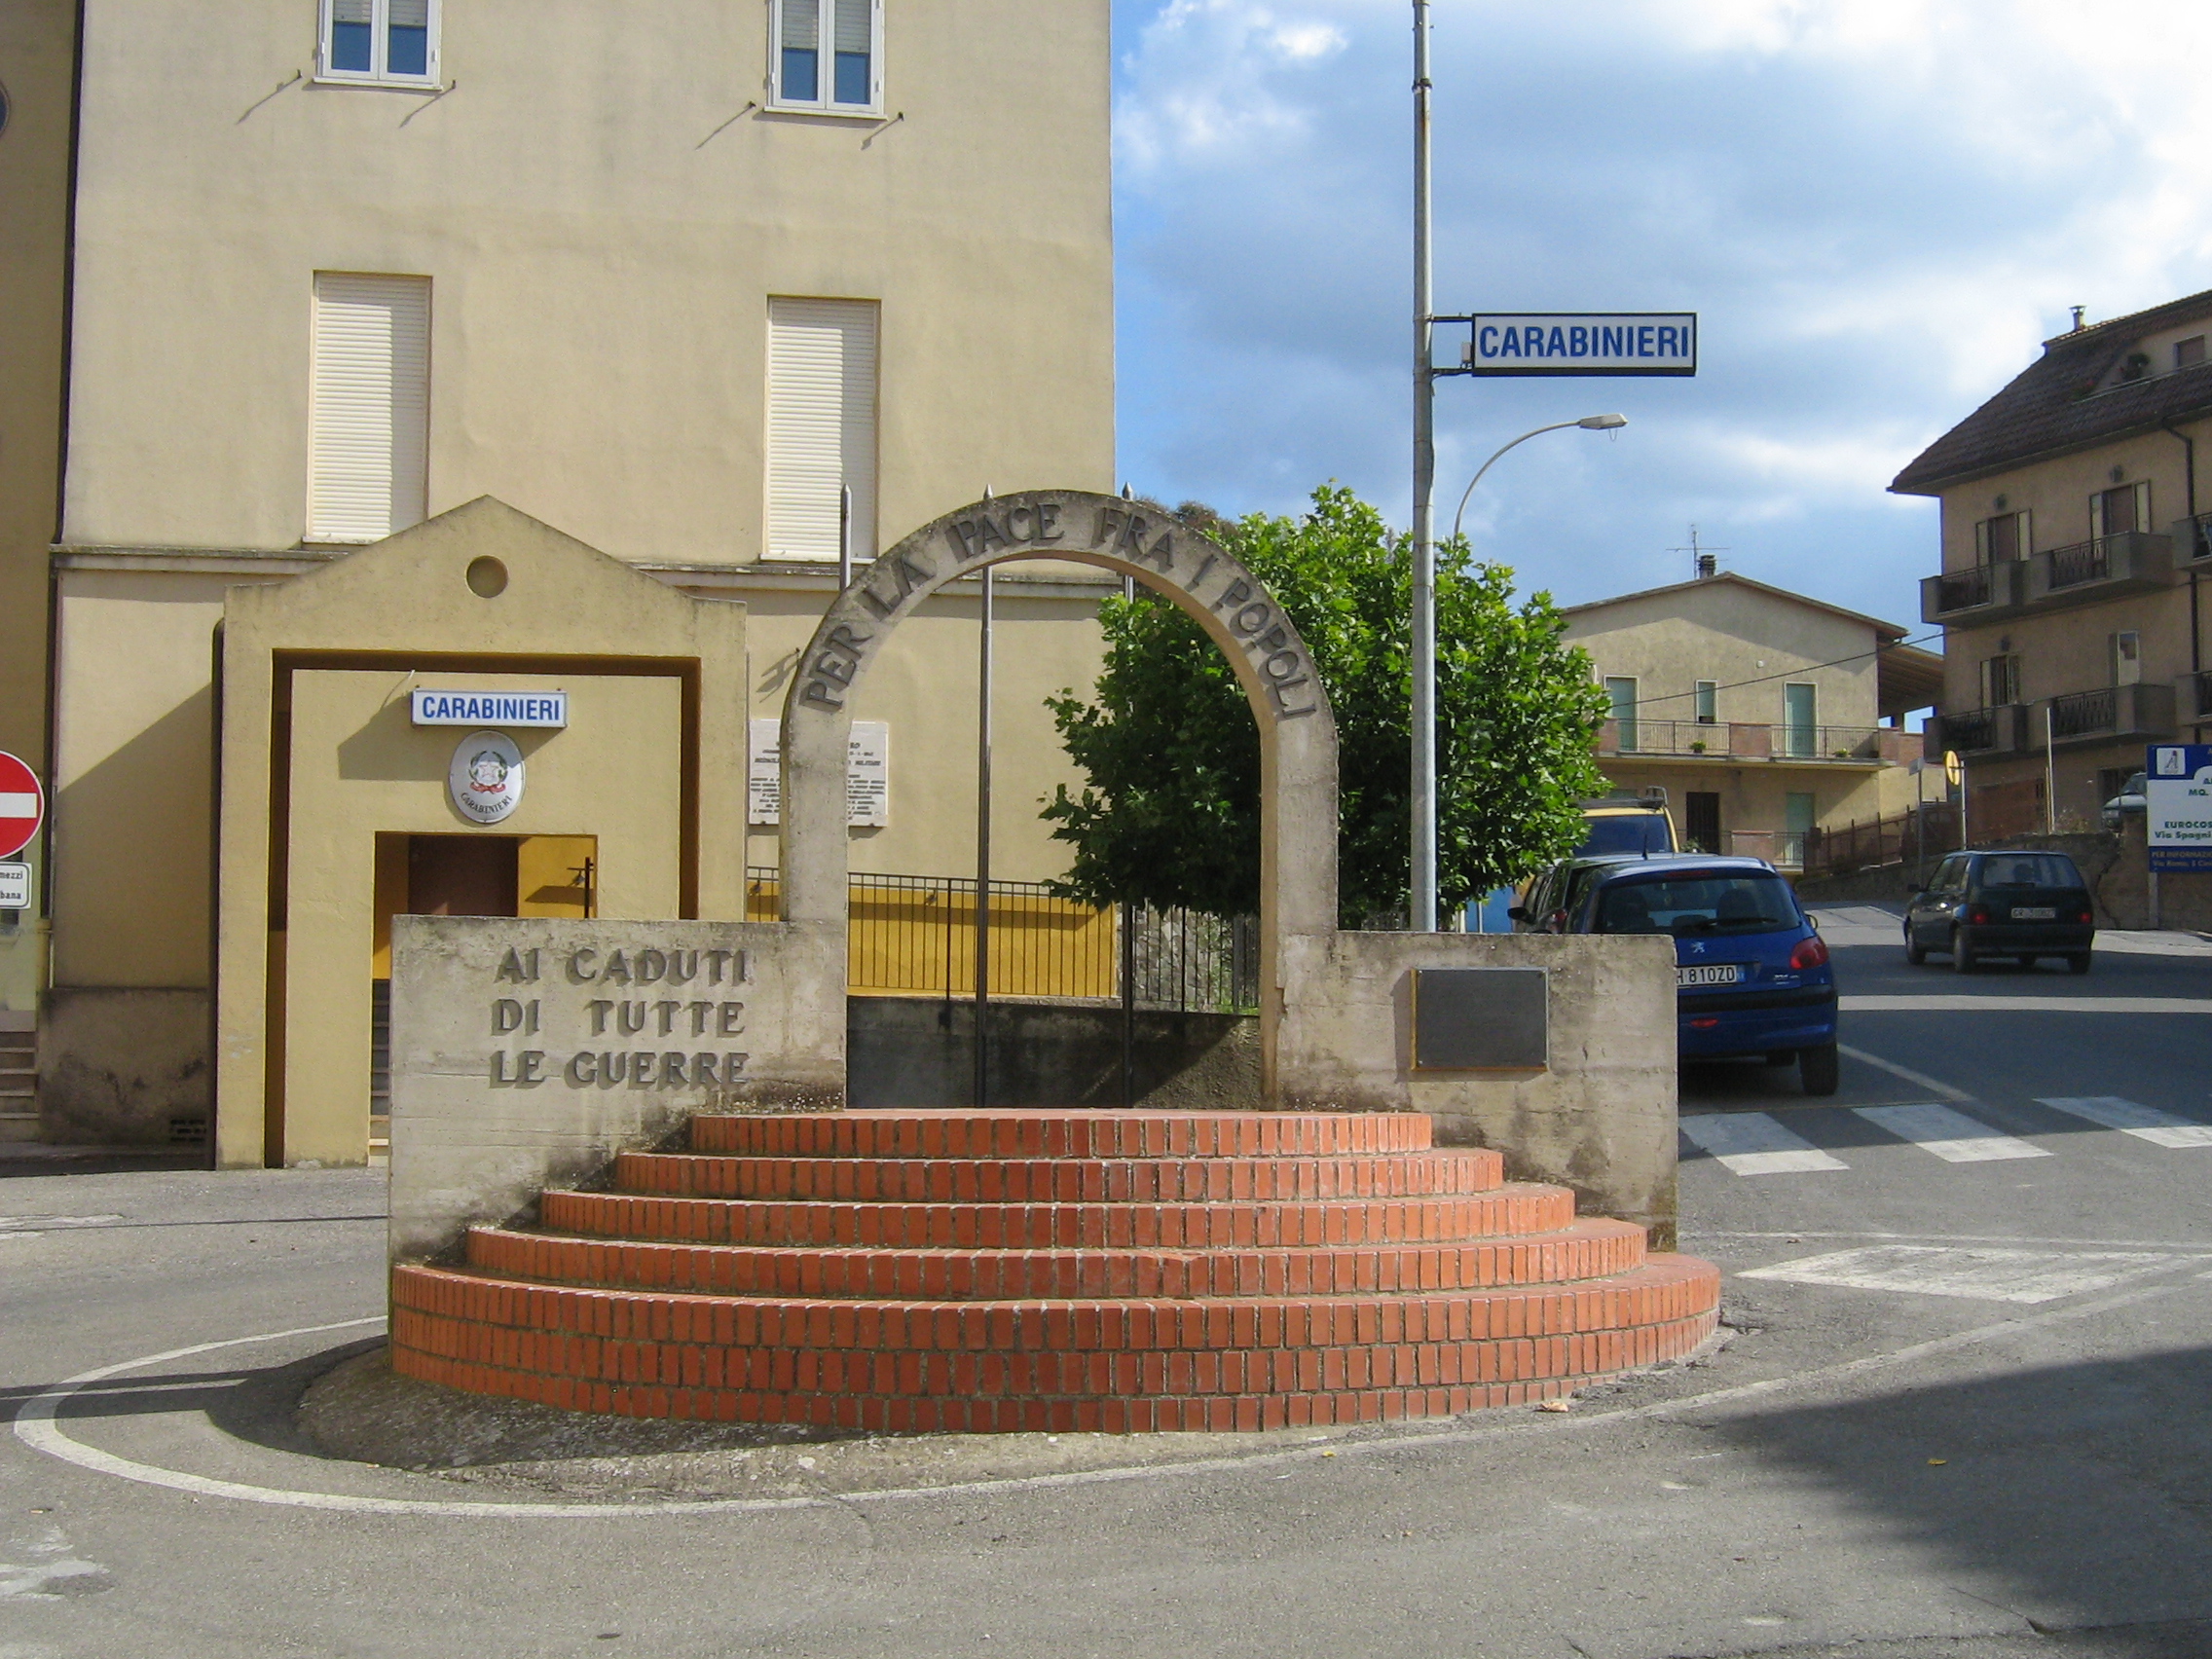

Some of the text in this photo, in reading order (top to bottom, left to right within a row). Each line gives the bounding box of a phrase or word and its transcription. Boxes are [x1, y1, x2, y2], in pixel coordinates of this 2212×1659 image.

[1479, 325, 1688, 358] CARABINIERI
[800, 502, 1317, 720] PER LA PACE FRA I POPOLI
[422, 695, 560, 721] CARABINIERI
[460, 791, 513, 815] CARABINIERI
[497, 946, 747, 984] AI CADUTI
[494, 999, 746, 1036] DI TUTTE
[492, 1051, 750, 1088] LE GUERRE
